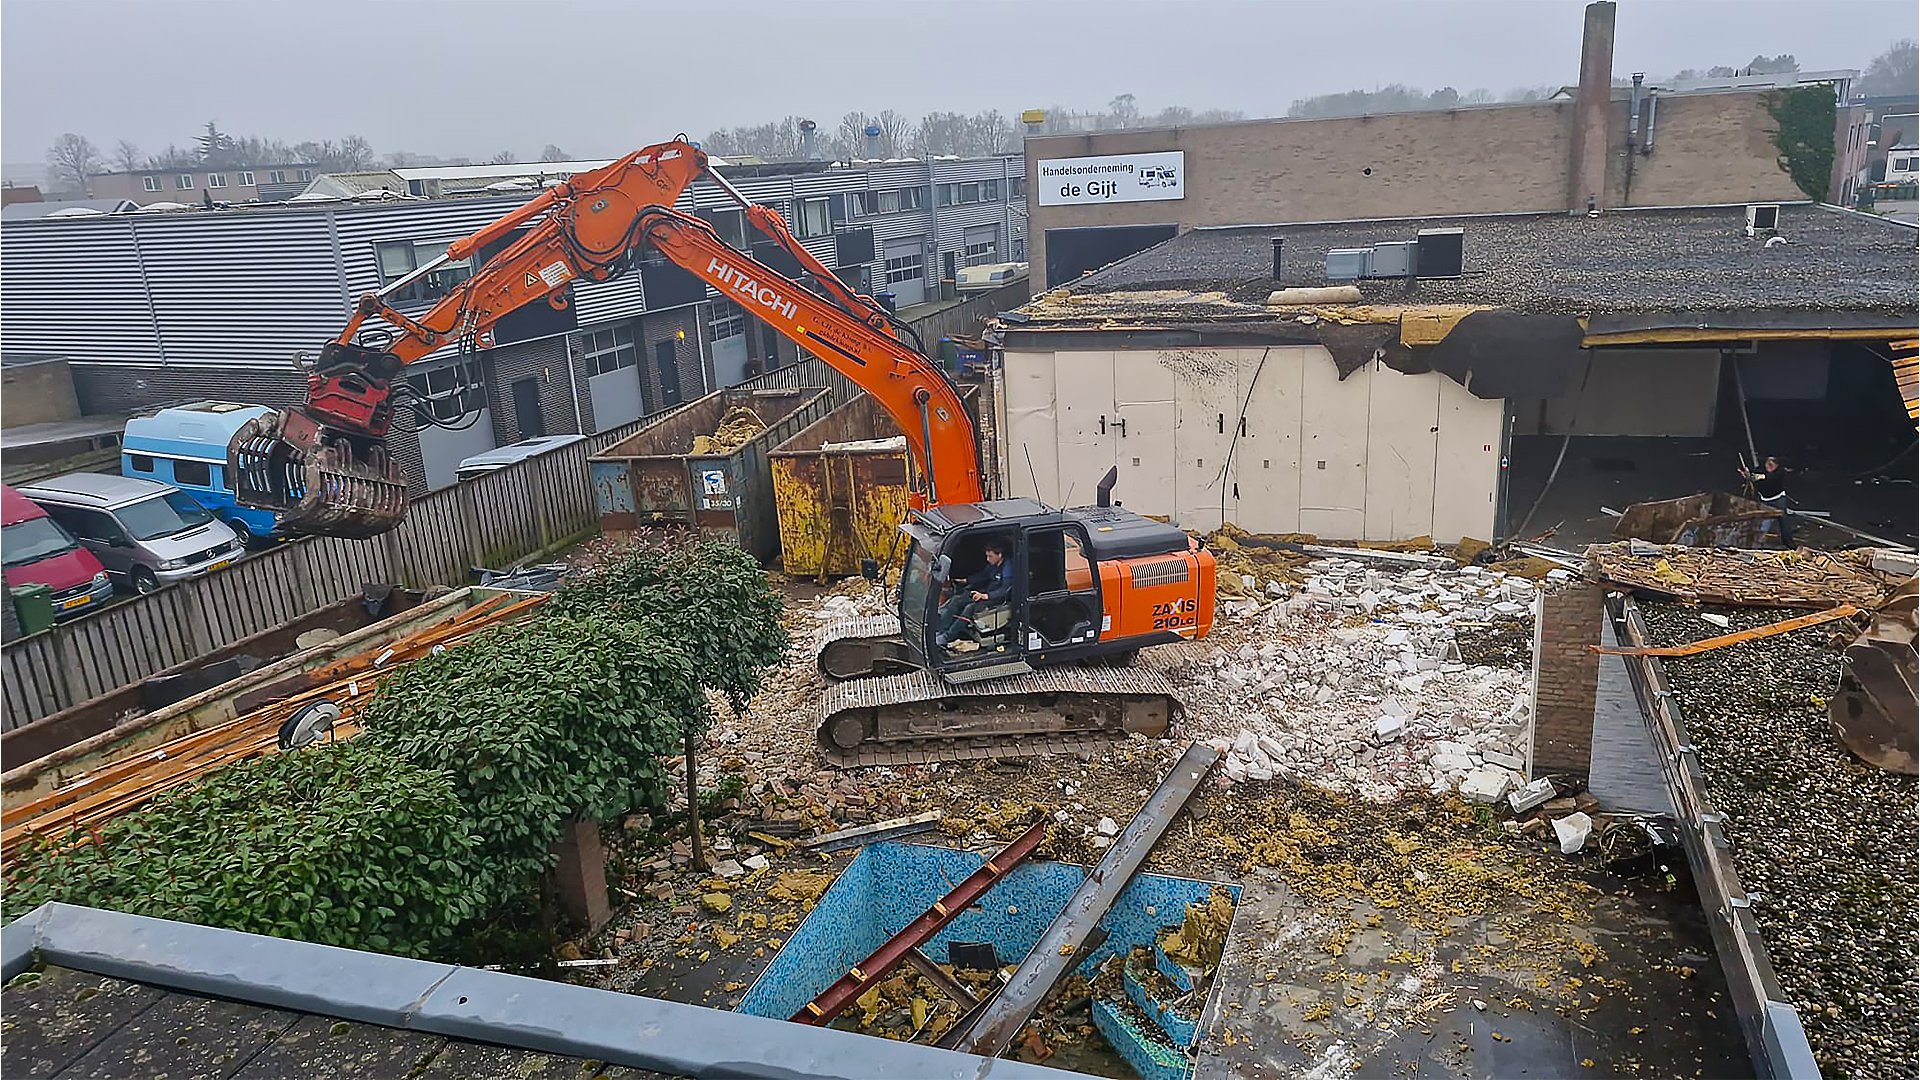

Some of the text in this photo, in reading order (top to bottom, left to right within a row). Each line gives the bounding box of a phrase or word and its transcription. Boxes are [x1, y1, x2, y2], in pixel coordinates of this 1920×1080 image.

[1042, 163, 1134, 176] Handelsonderneming
[1060, 180, 1118, 198] de Gijt
[706, 257, 798, 320] HITACHI
[1152, 598, 1195, 616] ZAXIS
